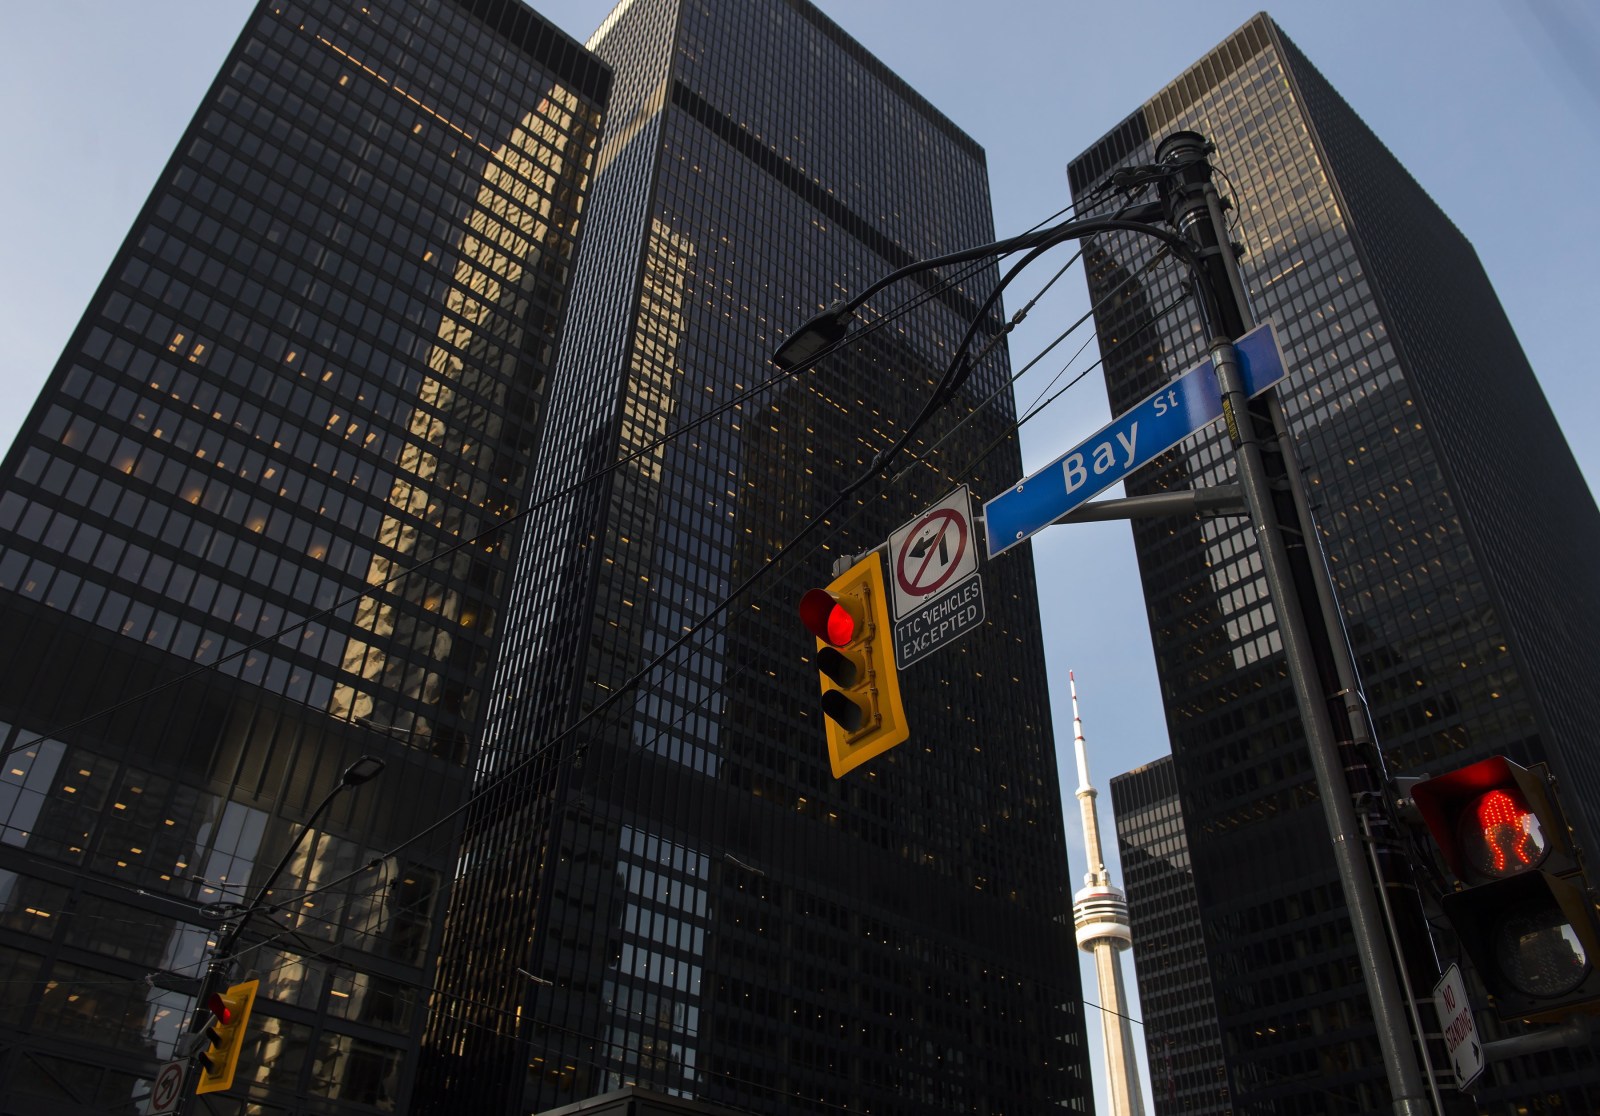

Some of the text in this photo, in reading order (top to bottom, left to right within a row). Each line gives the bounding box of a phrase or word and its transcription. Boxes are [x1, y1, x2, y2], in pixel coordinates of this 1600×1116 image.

[1062, 390, 1178, 495] Bay St
[898, 582, 979, 641] TTC VEHICLES
[903, 604, 977, 659] EXCEPTED
[1442, 984, 1456, 1015] NO
[1445, 1007, 1473, 1054] STANDING
